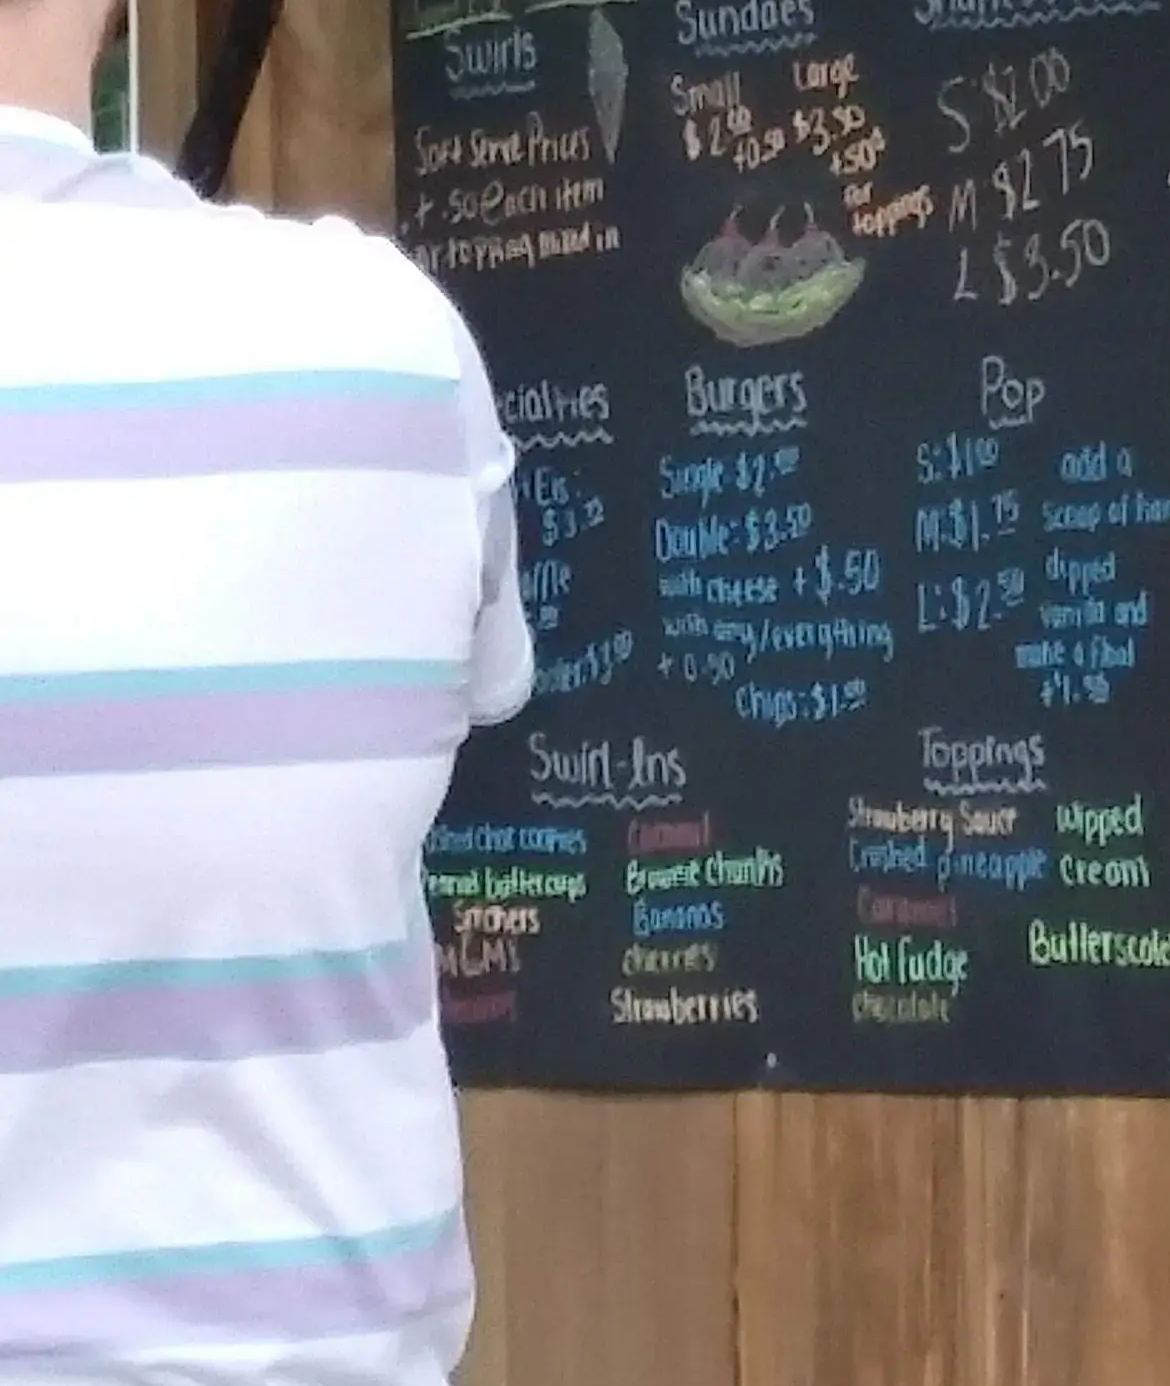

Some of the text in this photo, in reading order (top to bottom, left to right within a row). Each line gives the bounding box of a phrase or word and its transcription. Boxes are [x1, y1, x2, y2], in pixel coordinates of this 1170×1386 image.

[445, 25, 539, 85] Swirls
[669, 51, 860, 117] Small Large
[554, 176, 605, 213] item
[948, 177, 978, 234] M
[952, 247, 979, 301] L
[685, 365, 807, 417] Burgers
[979, 354, 1047, 425] Pop
[1044, 545, 1117, 596] dipped
[528, 730, 688, 791] Swirl-Ins
[918, 725, 1047, 785] Toppings
[847, 794, 954, 855] Strawberry
[936, 848, 1050, 894] pineapple
[634, 897, 727, 939] Bananas
[853, 933, 970, 999] Hot fudge
[609, 985, 761, 1027] Strawberries
